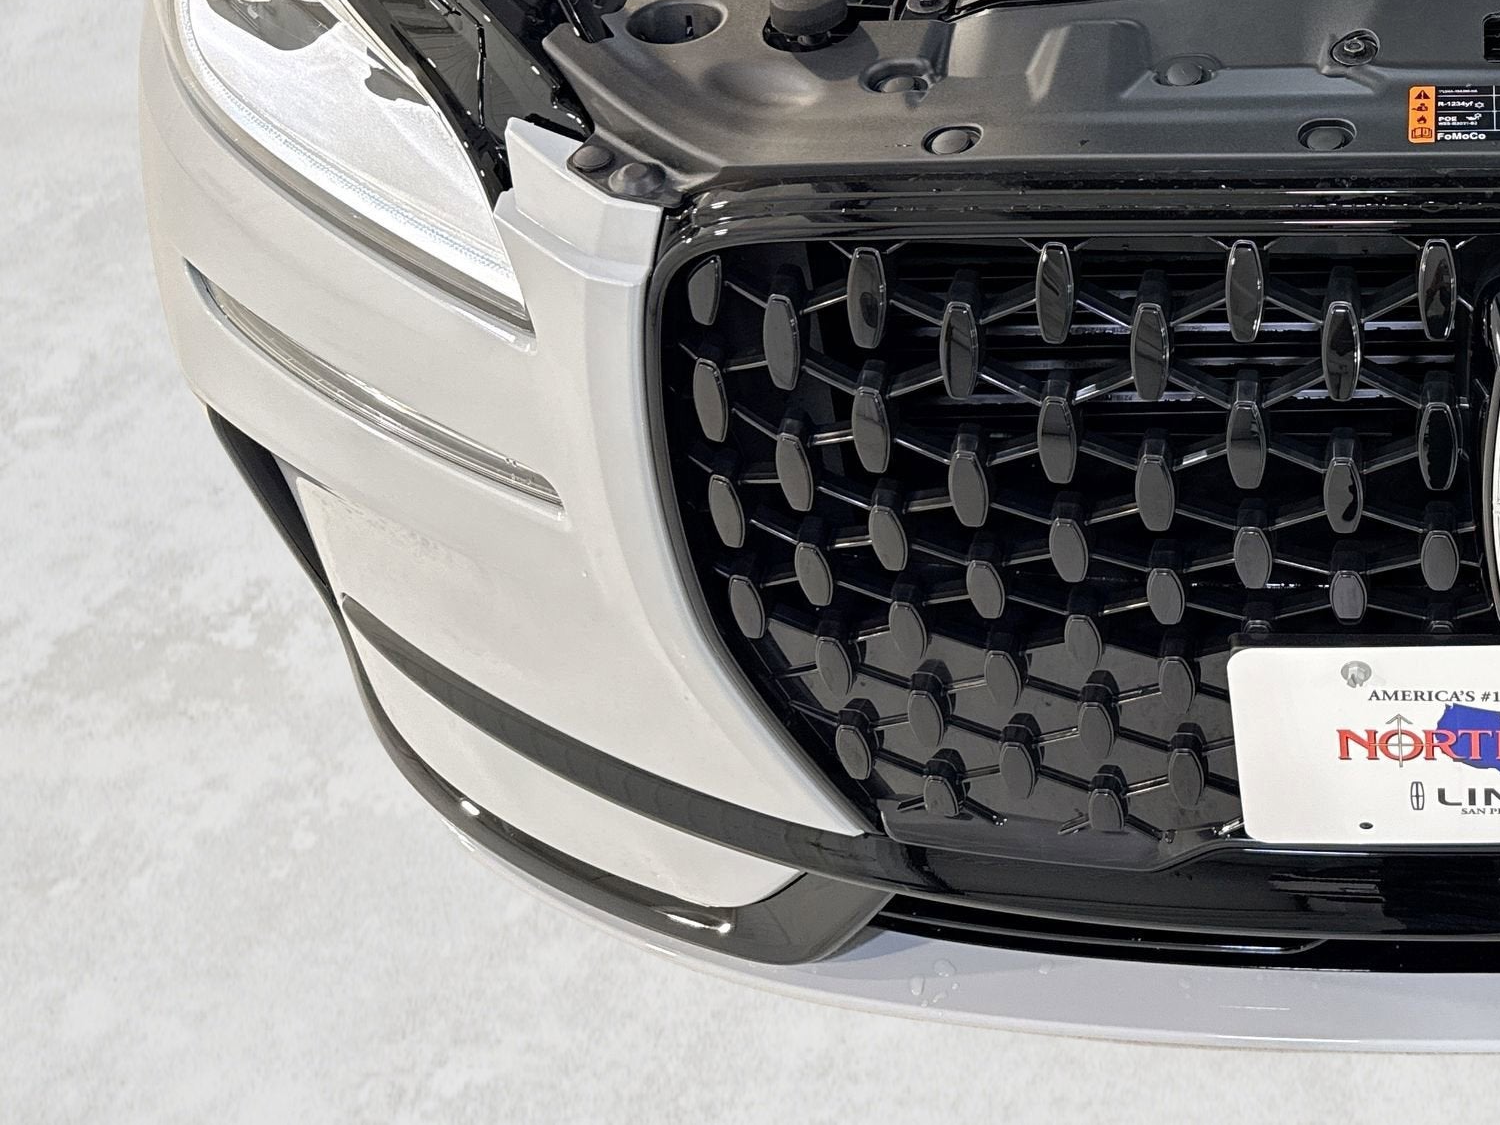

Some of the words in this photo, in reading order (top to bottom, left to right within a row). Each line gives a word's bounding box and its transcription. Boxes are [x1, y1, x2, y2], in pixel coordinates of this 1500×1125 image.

[1437, 132, 1486, 140] FoMoCo
[1368, 689, 1475, 702] AMERICA'S
[1481, 690, 1500, 702] #1
[1461, 807, 1486, 815] SAN
